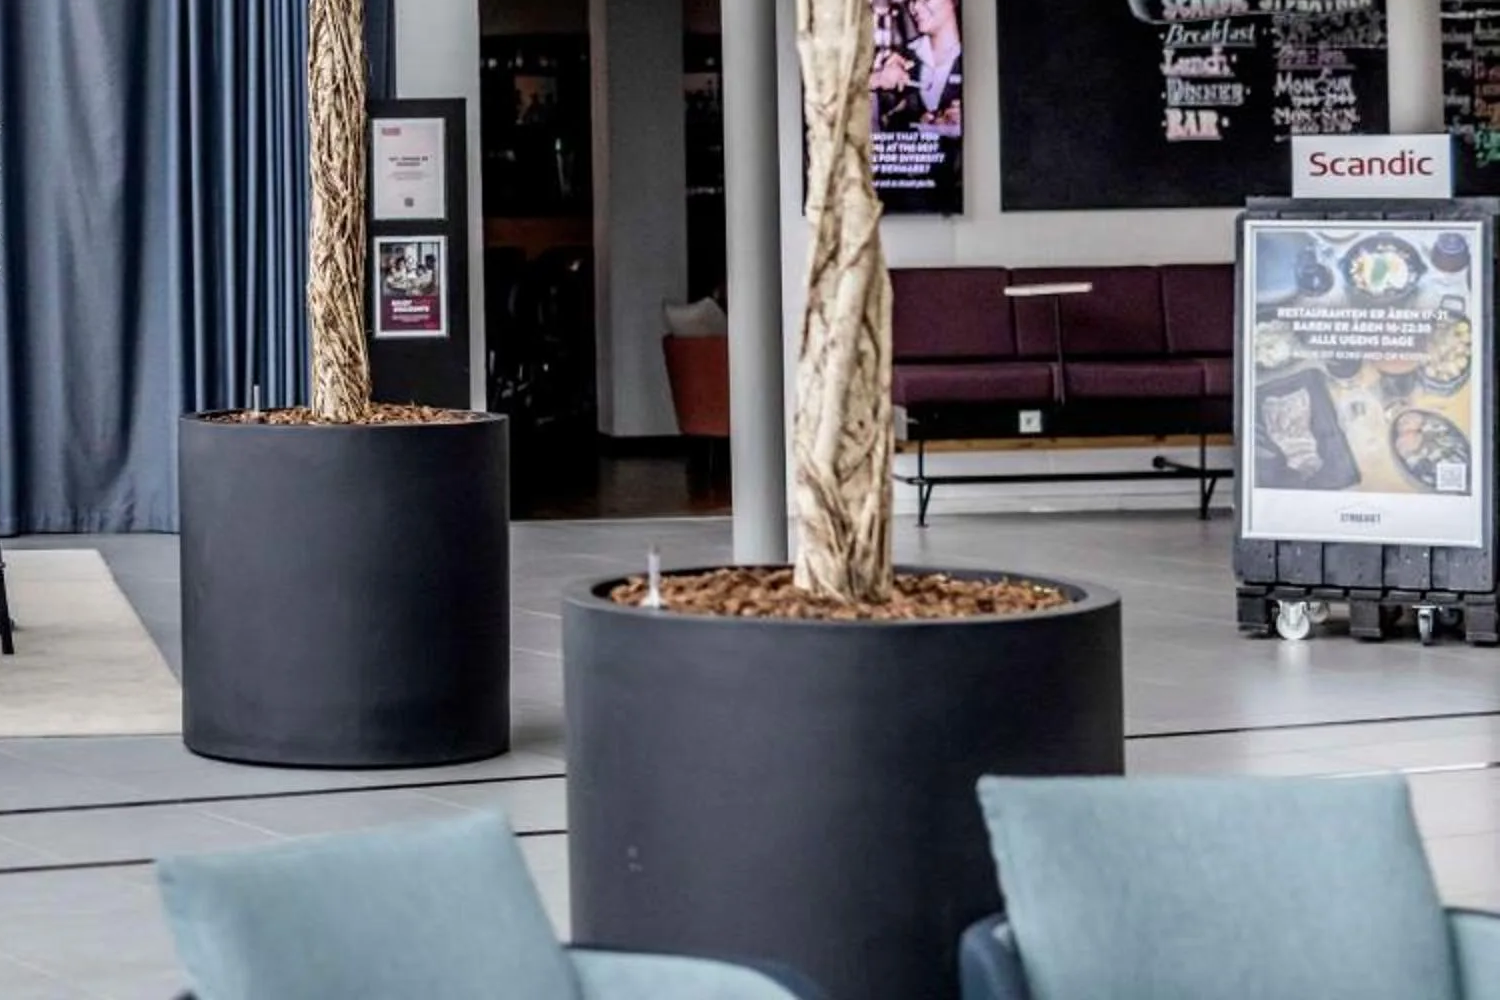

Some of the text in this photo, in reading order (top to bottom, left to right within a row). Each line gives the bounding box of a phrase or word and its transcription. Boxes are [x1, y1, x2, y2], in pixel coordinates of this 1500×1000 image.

[1166, 110, 1221, 140] BAR
[1309, 150, 1434, 177] Scandic
[1277, 307, 1367, 319] RESTAURANTEN
[1370, 309, 1385, 319] ER
[1387, 306, 1419, 319] ÅBEN
[1293, 321, 1332, 332] BAREN
[1334, 322, 1350, 332] ER
[1352, 319, 1384, 332] ÅBEN
[1308, 335, 1415, 347] ALLE UGENS DAGE
